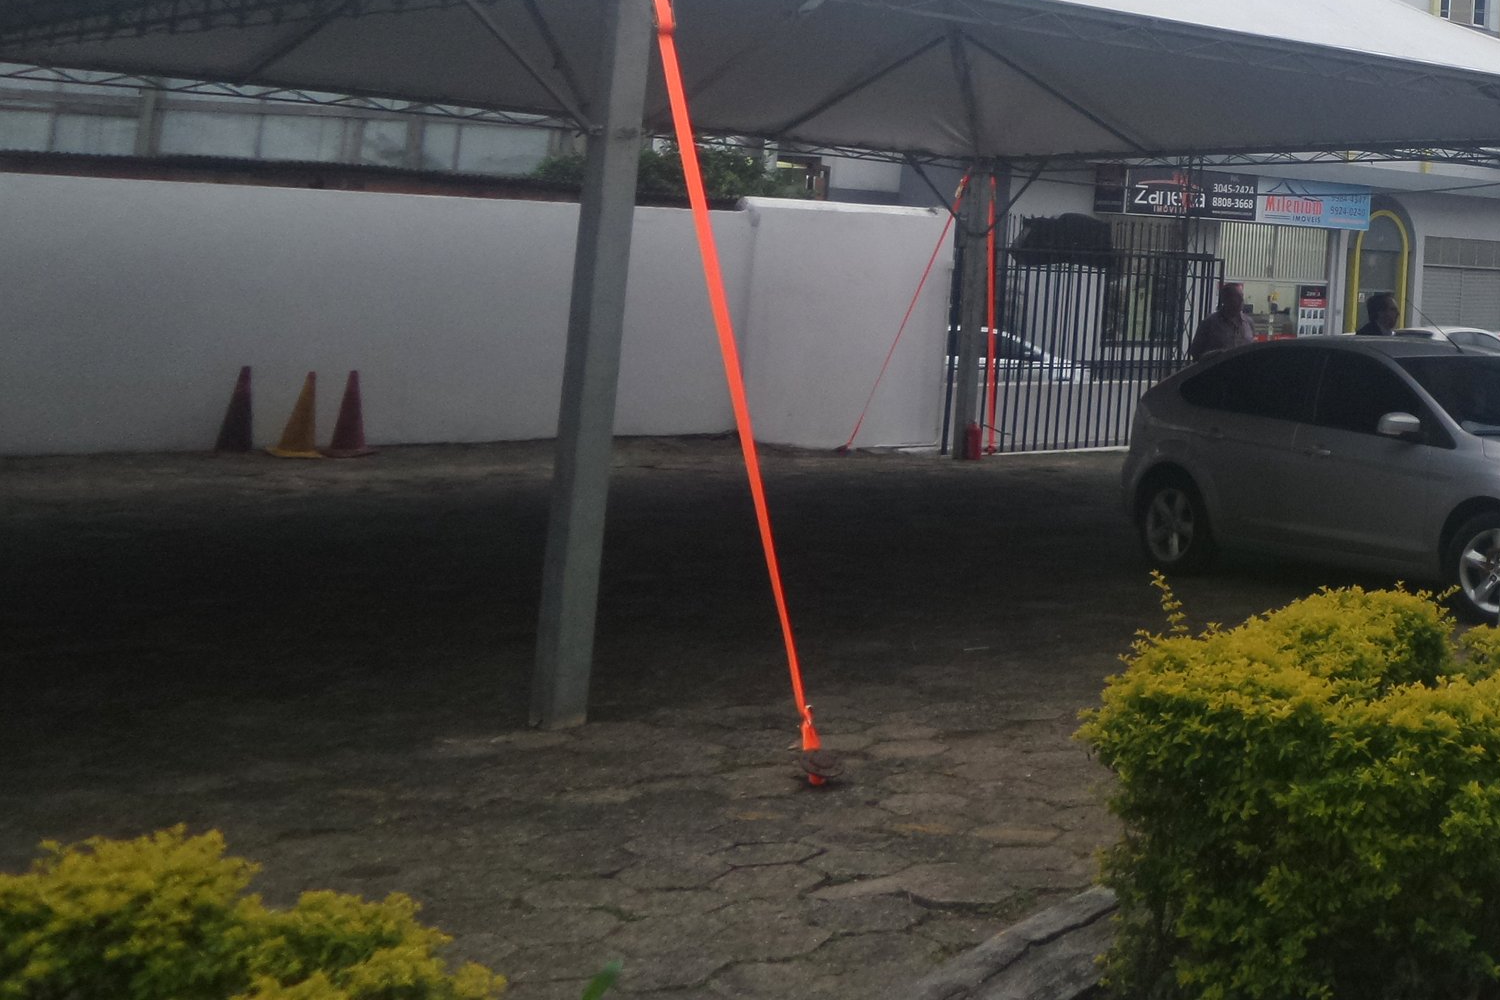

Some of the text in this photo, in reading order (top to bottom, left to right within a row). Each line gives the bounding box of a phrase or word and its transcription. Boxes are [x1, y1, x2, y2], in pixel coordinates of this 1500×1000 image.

[1213, 183, 1255, 195] 3045-2424
[1212, 196, 1254, 209] 8808-3668
[1265, 194, 1323, 215] Milenium
